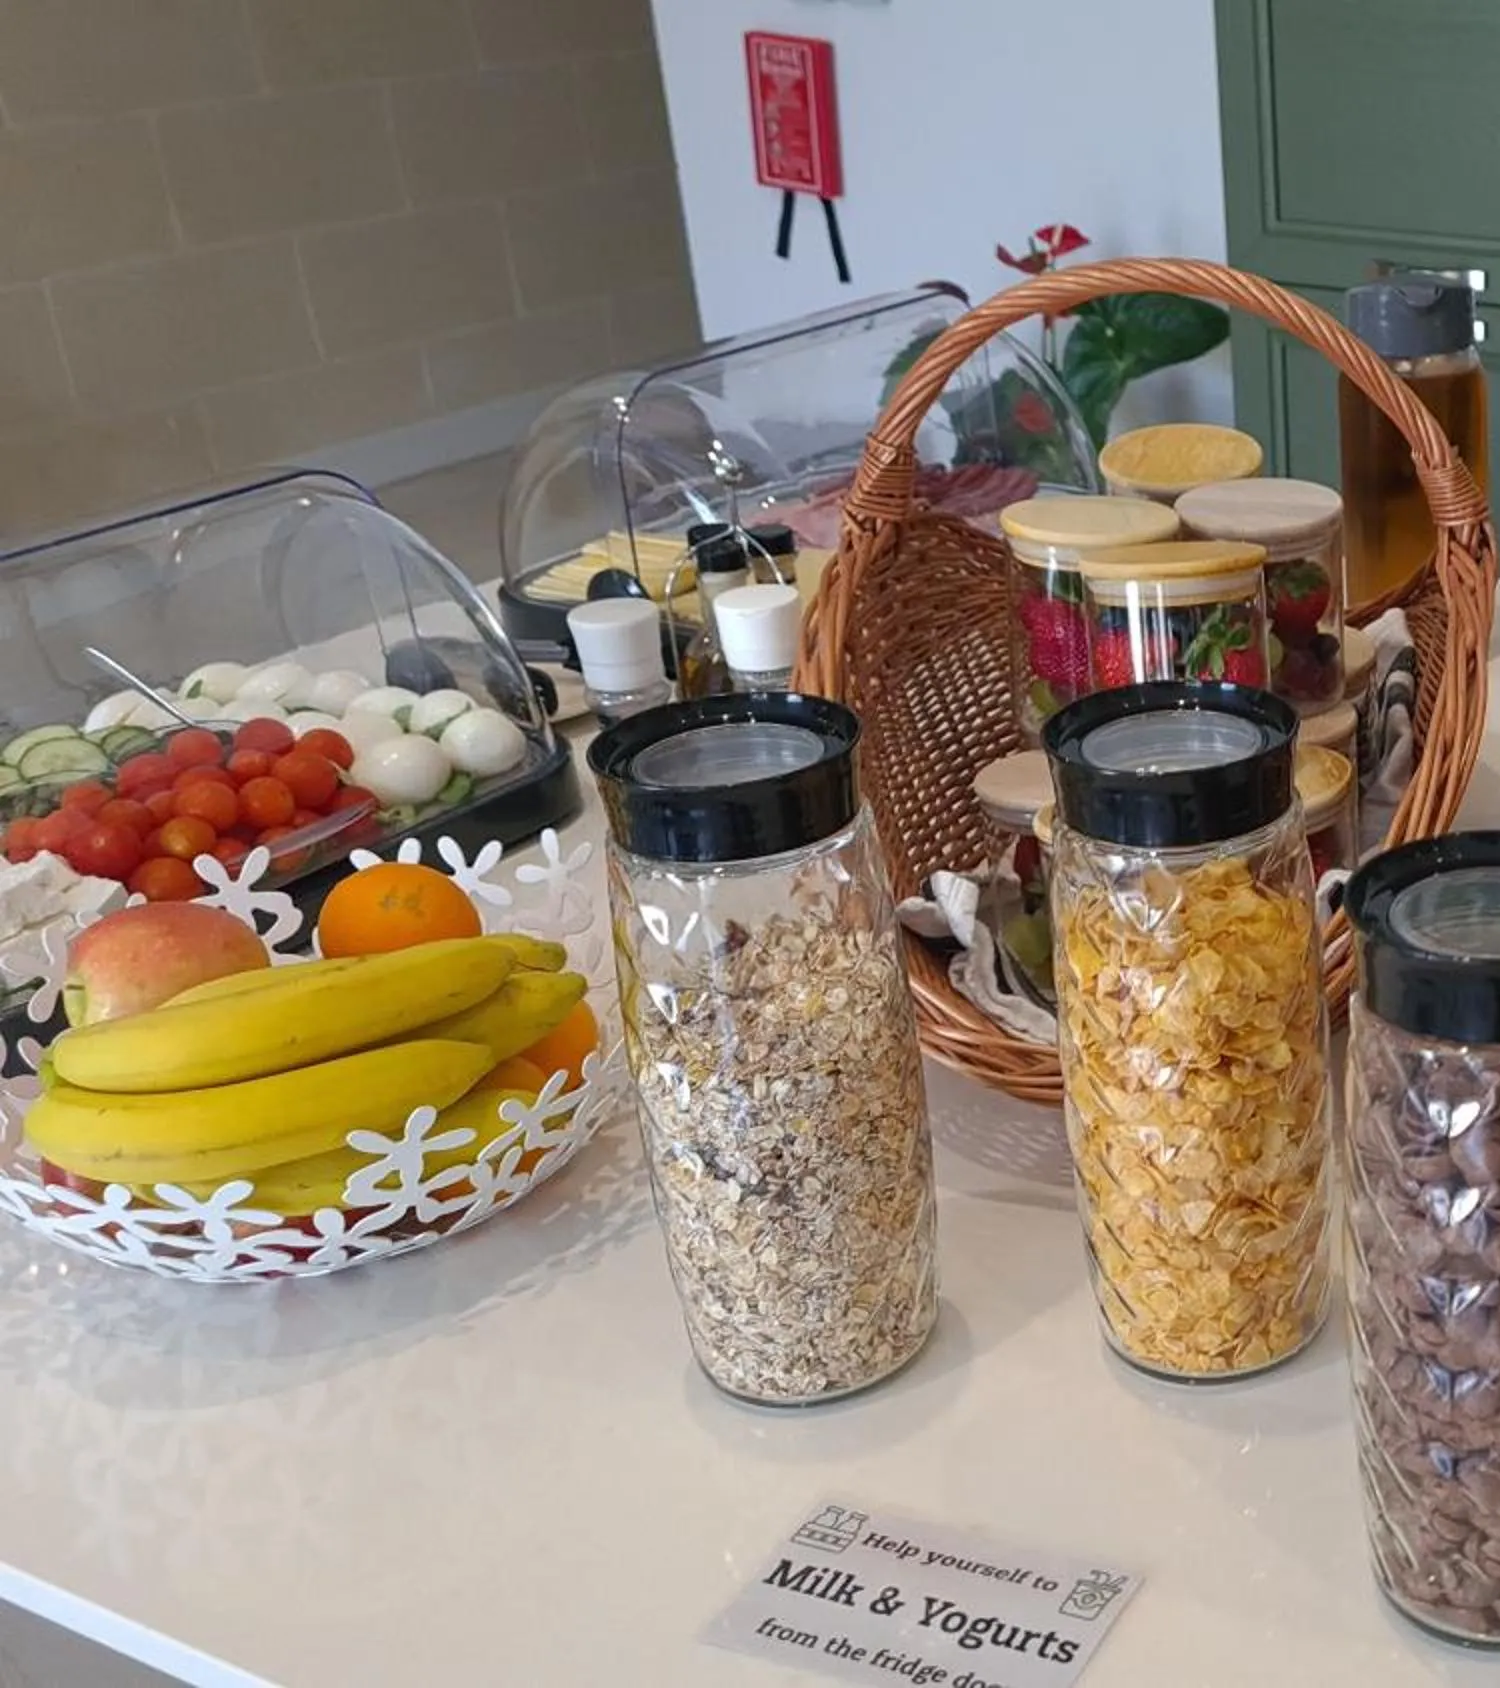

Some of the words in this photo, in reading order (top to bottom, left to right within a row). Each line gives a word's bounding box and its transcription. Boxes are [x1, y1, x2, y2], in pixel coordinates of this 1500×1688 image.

[861, 1532, 921, 1560] Help
[920, 1550, 1031, 1585] yourself
[1030, 1575, 1060, 1592] to
[762, 1558, 864, 1607] Milk
[868, 1586, 904, 1616] &
[917, 1597, 1081, 1664] Yogurts
[755, 1617, 820, 1649] from
[823, 1637, 868, 1661] the
[868, 1649, 948, 1685] fridge
